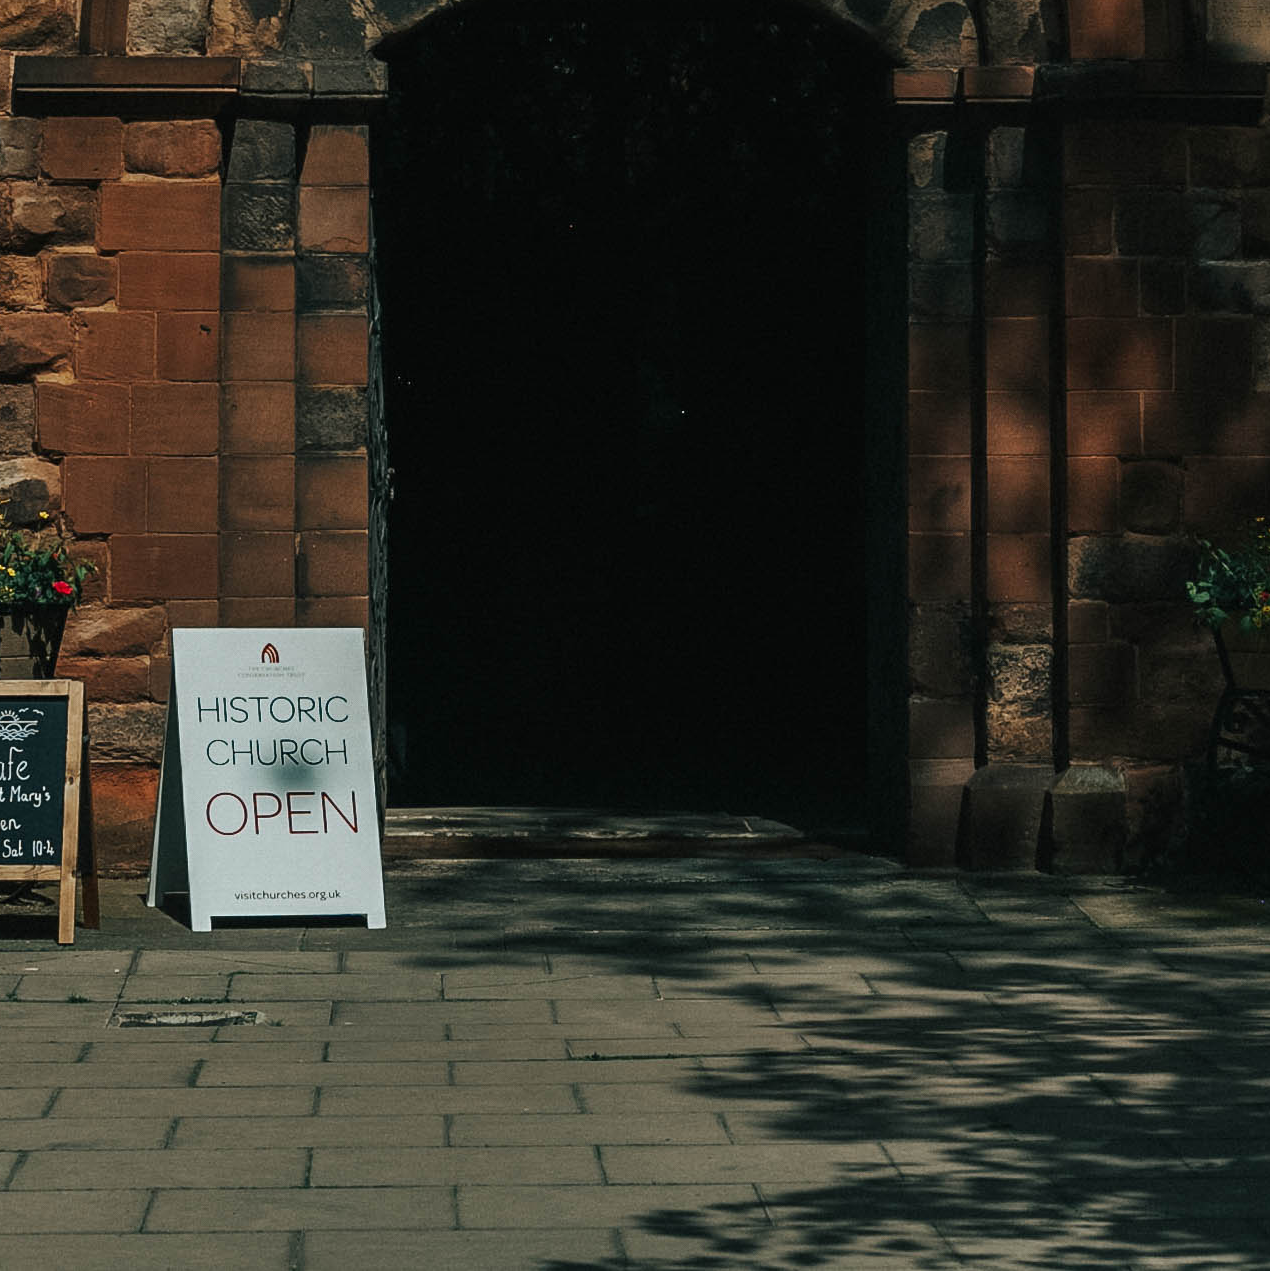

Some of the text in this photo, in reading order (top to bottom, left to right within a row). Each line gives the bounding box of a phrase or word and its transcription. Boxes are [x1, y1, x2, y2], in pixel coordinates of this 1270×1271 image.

[197, 695, 349, 723] HISTORIC
[205, 738, 349, 766] CHURCH
[9, 786, 51, 808] Mary's
[206, 790, 359, 836] OPEN
[2, 839, 23, 858] Sat
[234, 889, 342, 901] visitchurches.org.uk
